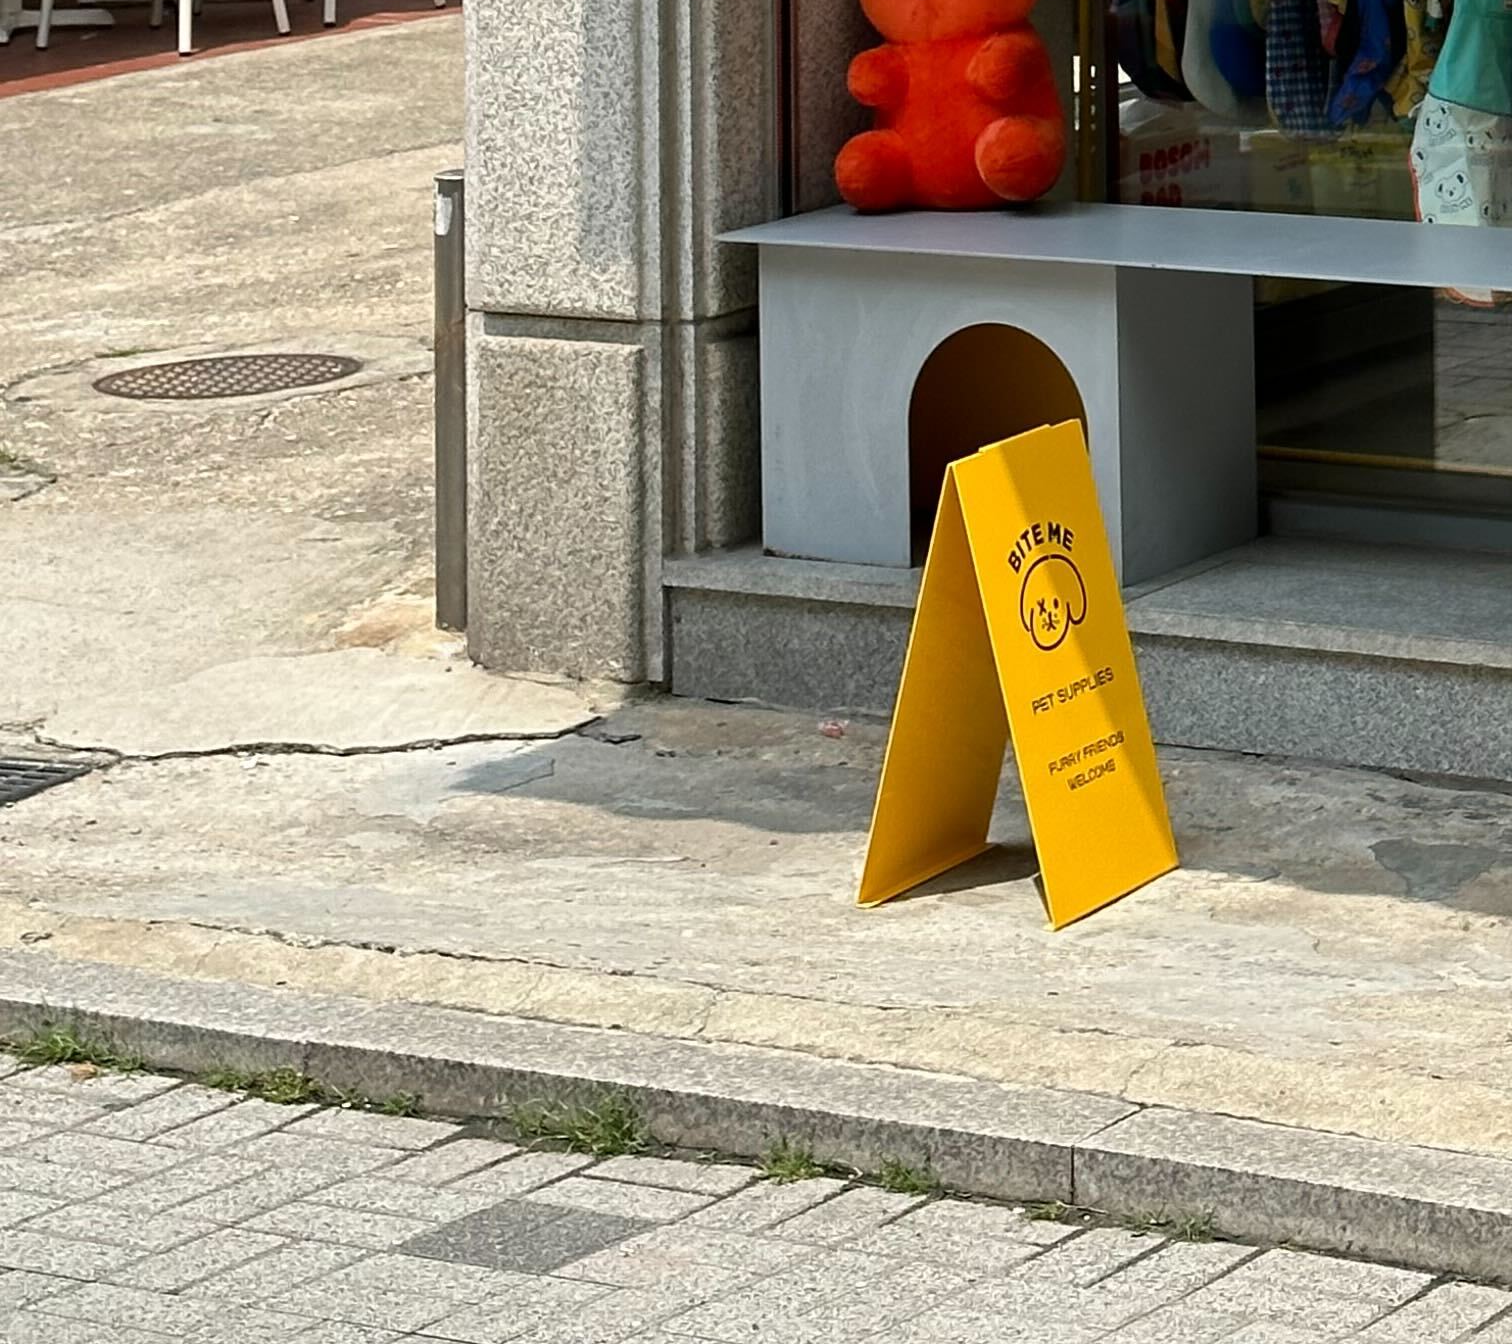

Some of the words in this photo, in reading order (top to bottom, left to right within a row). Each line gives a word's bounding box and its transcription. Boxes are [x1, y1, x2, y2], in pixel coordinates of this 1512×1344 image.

[1008, 523, 1045, 574] BITE
[1048, 521, 1075, 553] ME
[1031, 692, 1055, 715] PET
[1055, 666, 1115, 705] SUPPLIES
[1048, 748, 1082, 776] FURRY
[1082, 730, 1125, 761] FRIENDS
[1066, 758, 1117, 791] WELCOME
